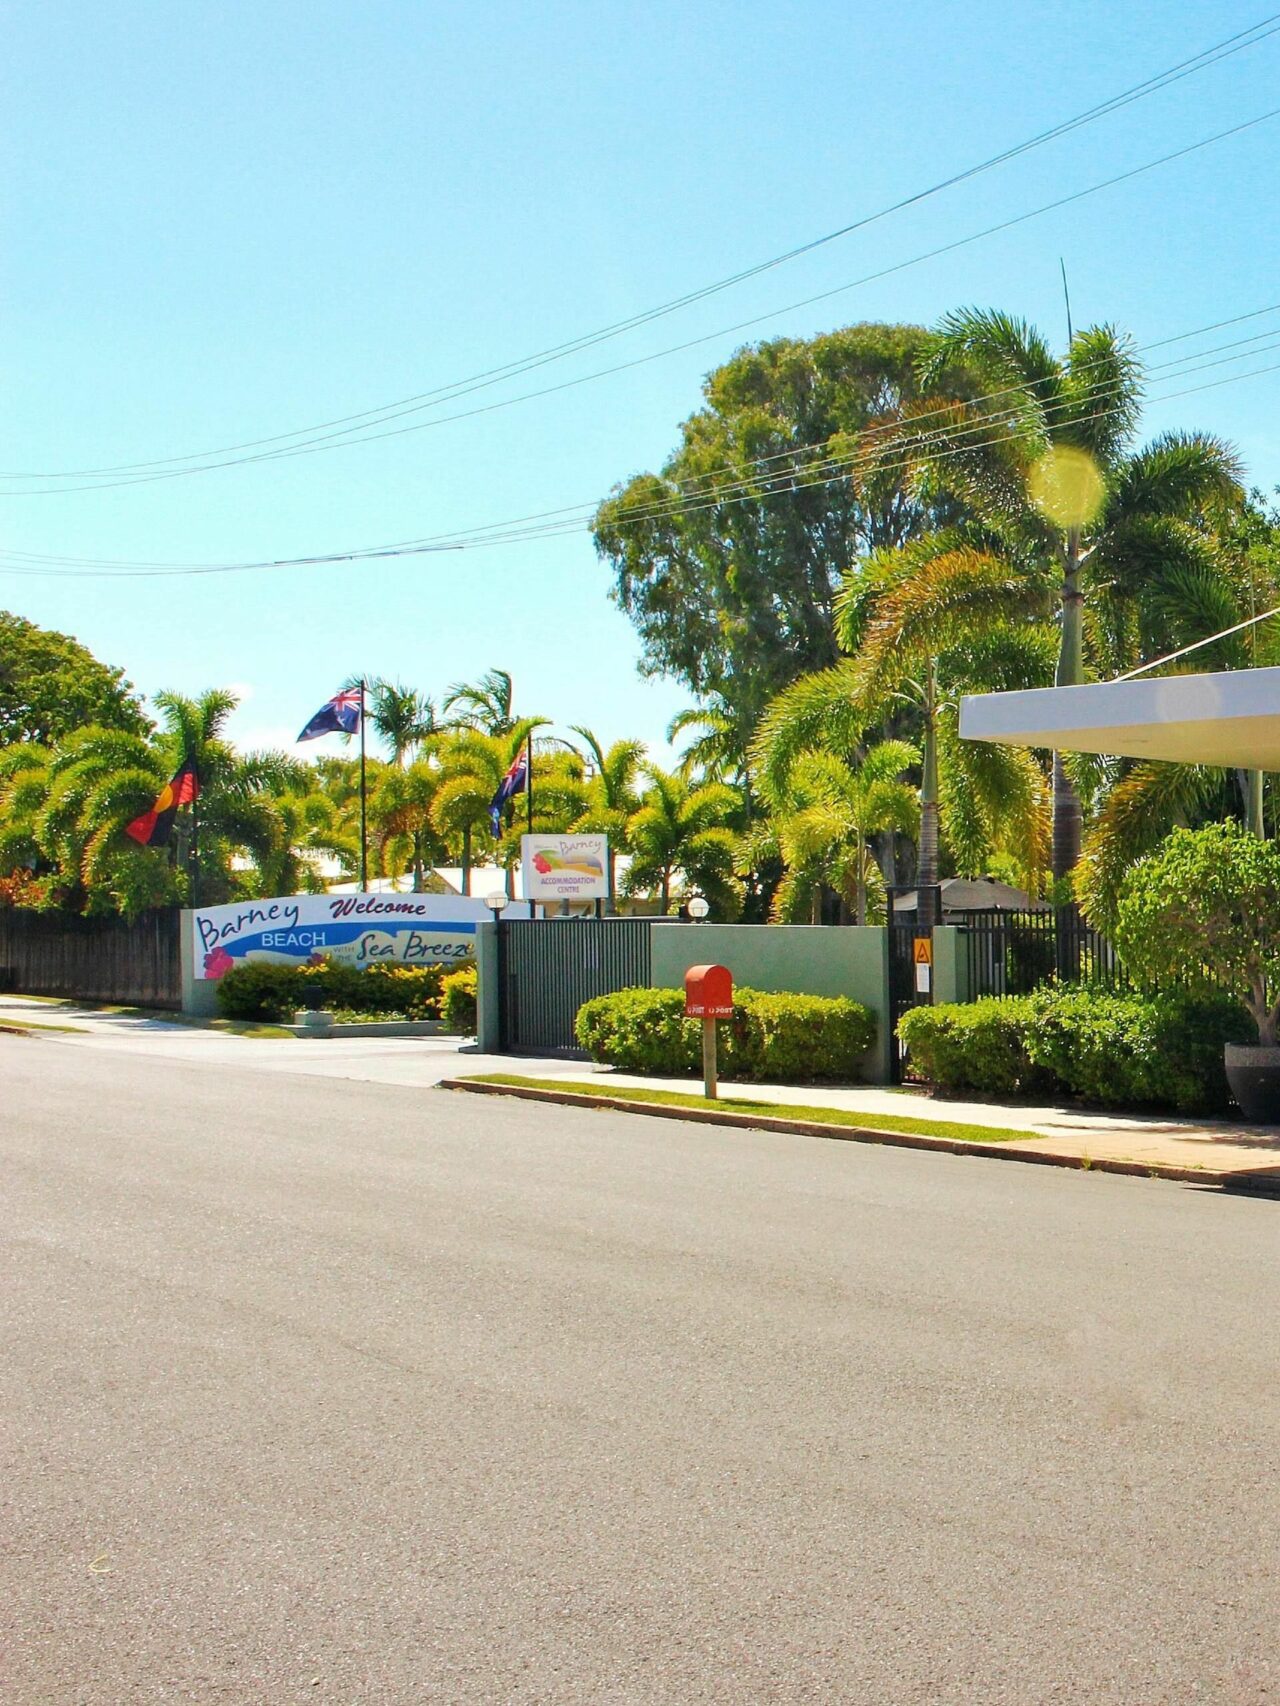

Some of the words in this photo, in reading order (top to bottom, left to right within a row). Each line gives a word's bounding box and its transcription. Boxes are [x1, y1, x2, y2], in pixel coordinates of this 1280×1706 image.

[540, 877, 596, 885] ACCOMMODATION
[557, 886, 580, 894] CENTRE
[329, 897, 427, 919] Welcome
[196, 905, 299, 952] Barney
[261, 932, 326, 947] BEACH
[356, 934, 396, 961] Sea
